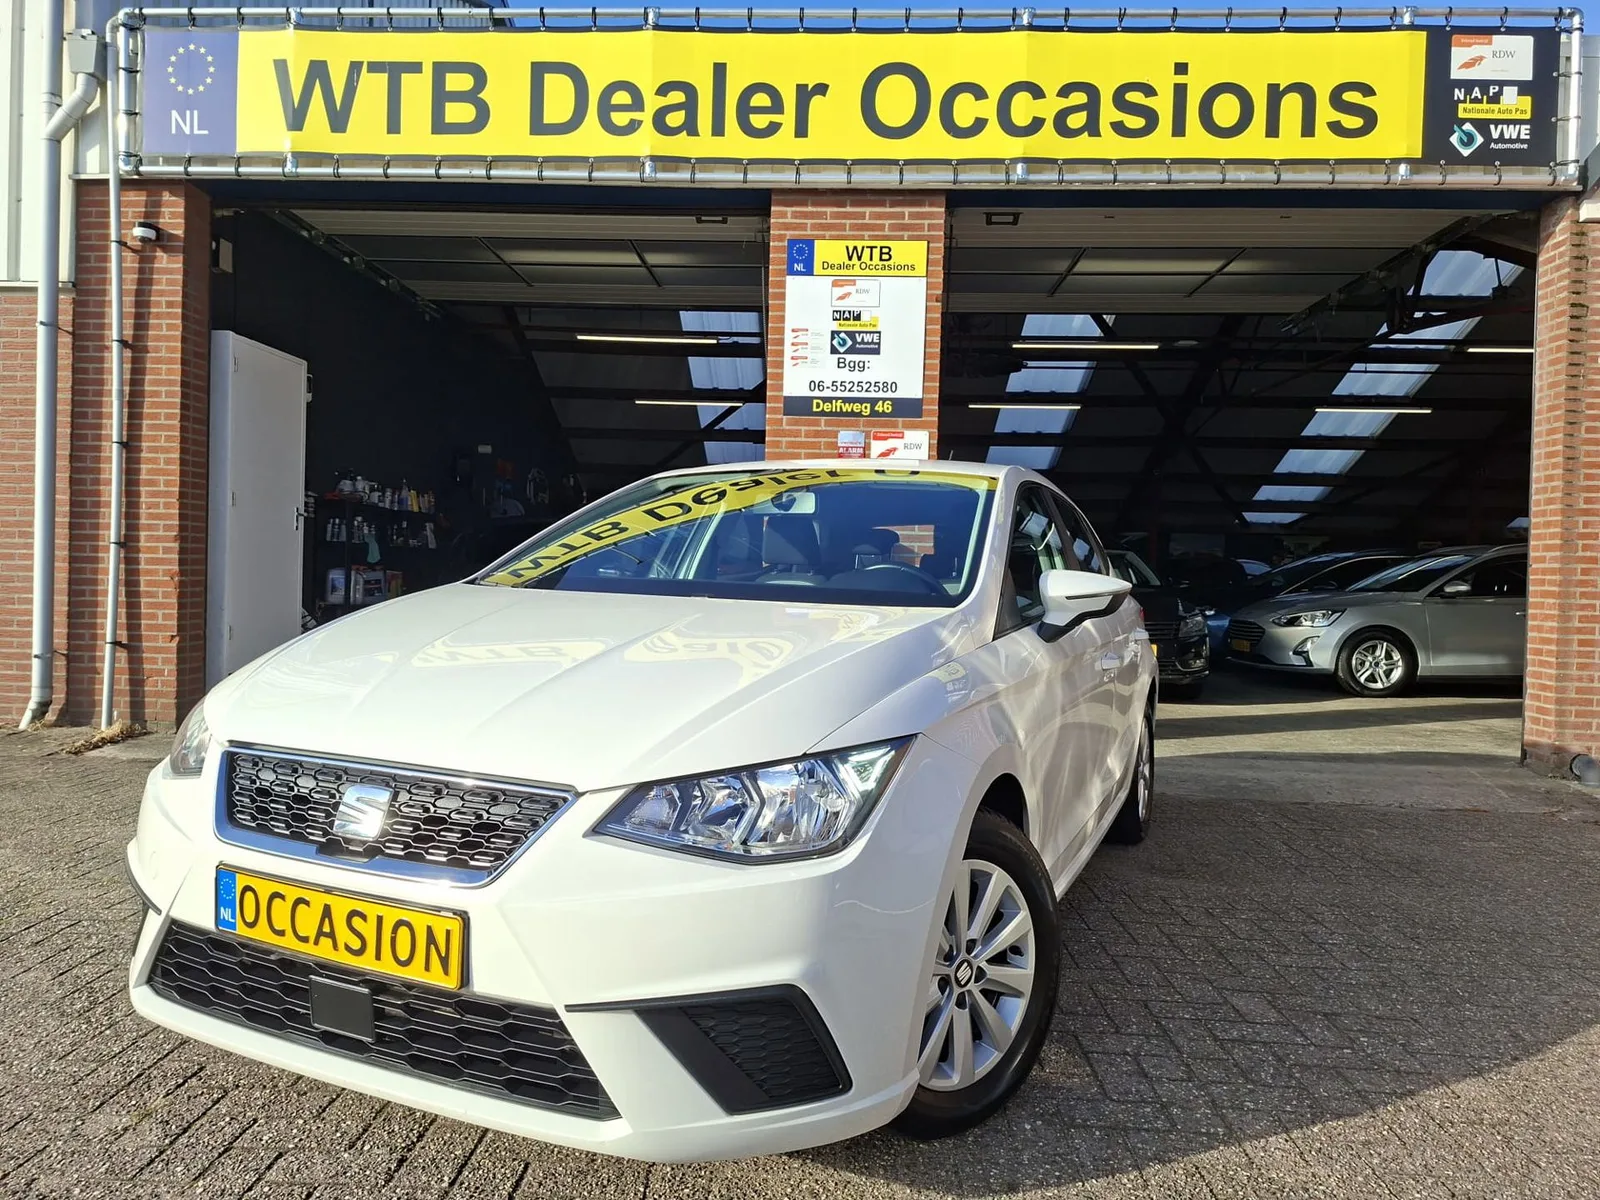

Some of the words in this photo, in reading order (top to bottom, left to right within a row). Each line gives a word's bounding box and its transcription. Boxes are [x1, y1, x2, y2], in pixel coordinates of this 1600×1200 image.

[1491, 50, 1515, 59] RDW
[272, 58, 491, 135] WTB
[529, 60, 830, 139] Dealer
[860, 61, 1379, 140] Occasions
[1462, 106, 1495, 115] Nationale
[1496, 107, 1513, 115] Auto
[1514, 107, 1528, 116] Pas
[170, 109, 209, 135] NL
[1489, 124, 1531, 139] VWE
[1489, 142, 1528, 150] Automotive
[845, 245, 893, 261] WTB
[793, 263, 806, 272] NL
[821, 261, 855, 271] Dealer
[859, 261, 916, 272] Occasions
[855, 333, 880, 343] VWE
[837, 357, 871, 373] Bgg:
[808, 380, 898, 393] 06-55252580
[812, 399, 871, 416] Delfweg
[874, 400, 893, 413] 46
[903, 442, 923, 451] RDW
[219, 907, 236, 923] NL
[239, 884, 452, 977] OCCASION
